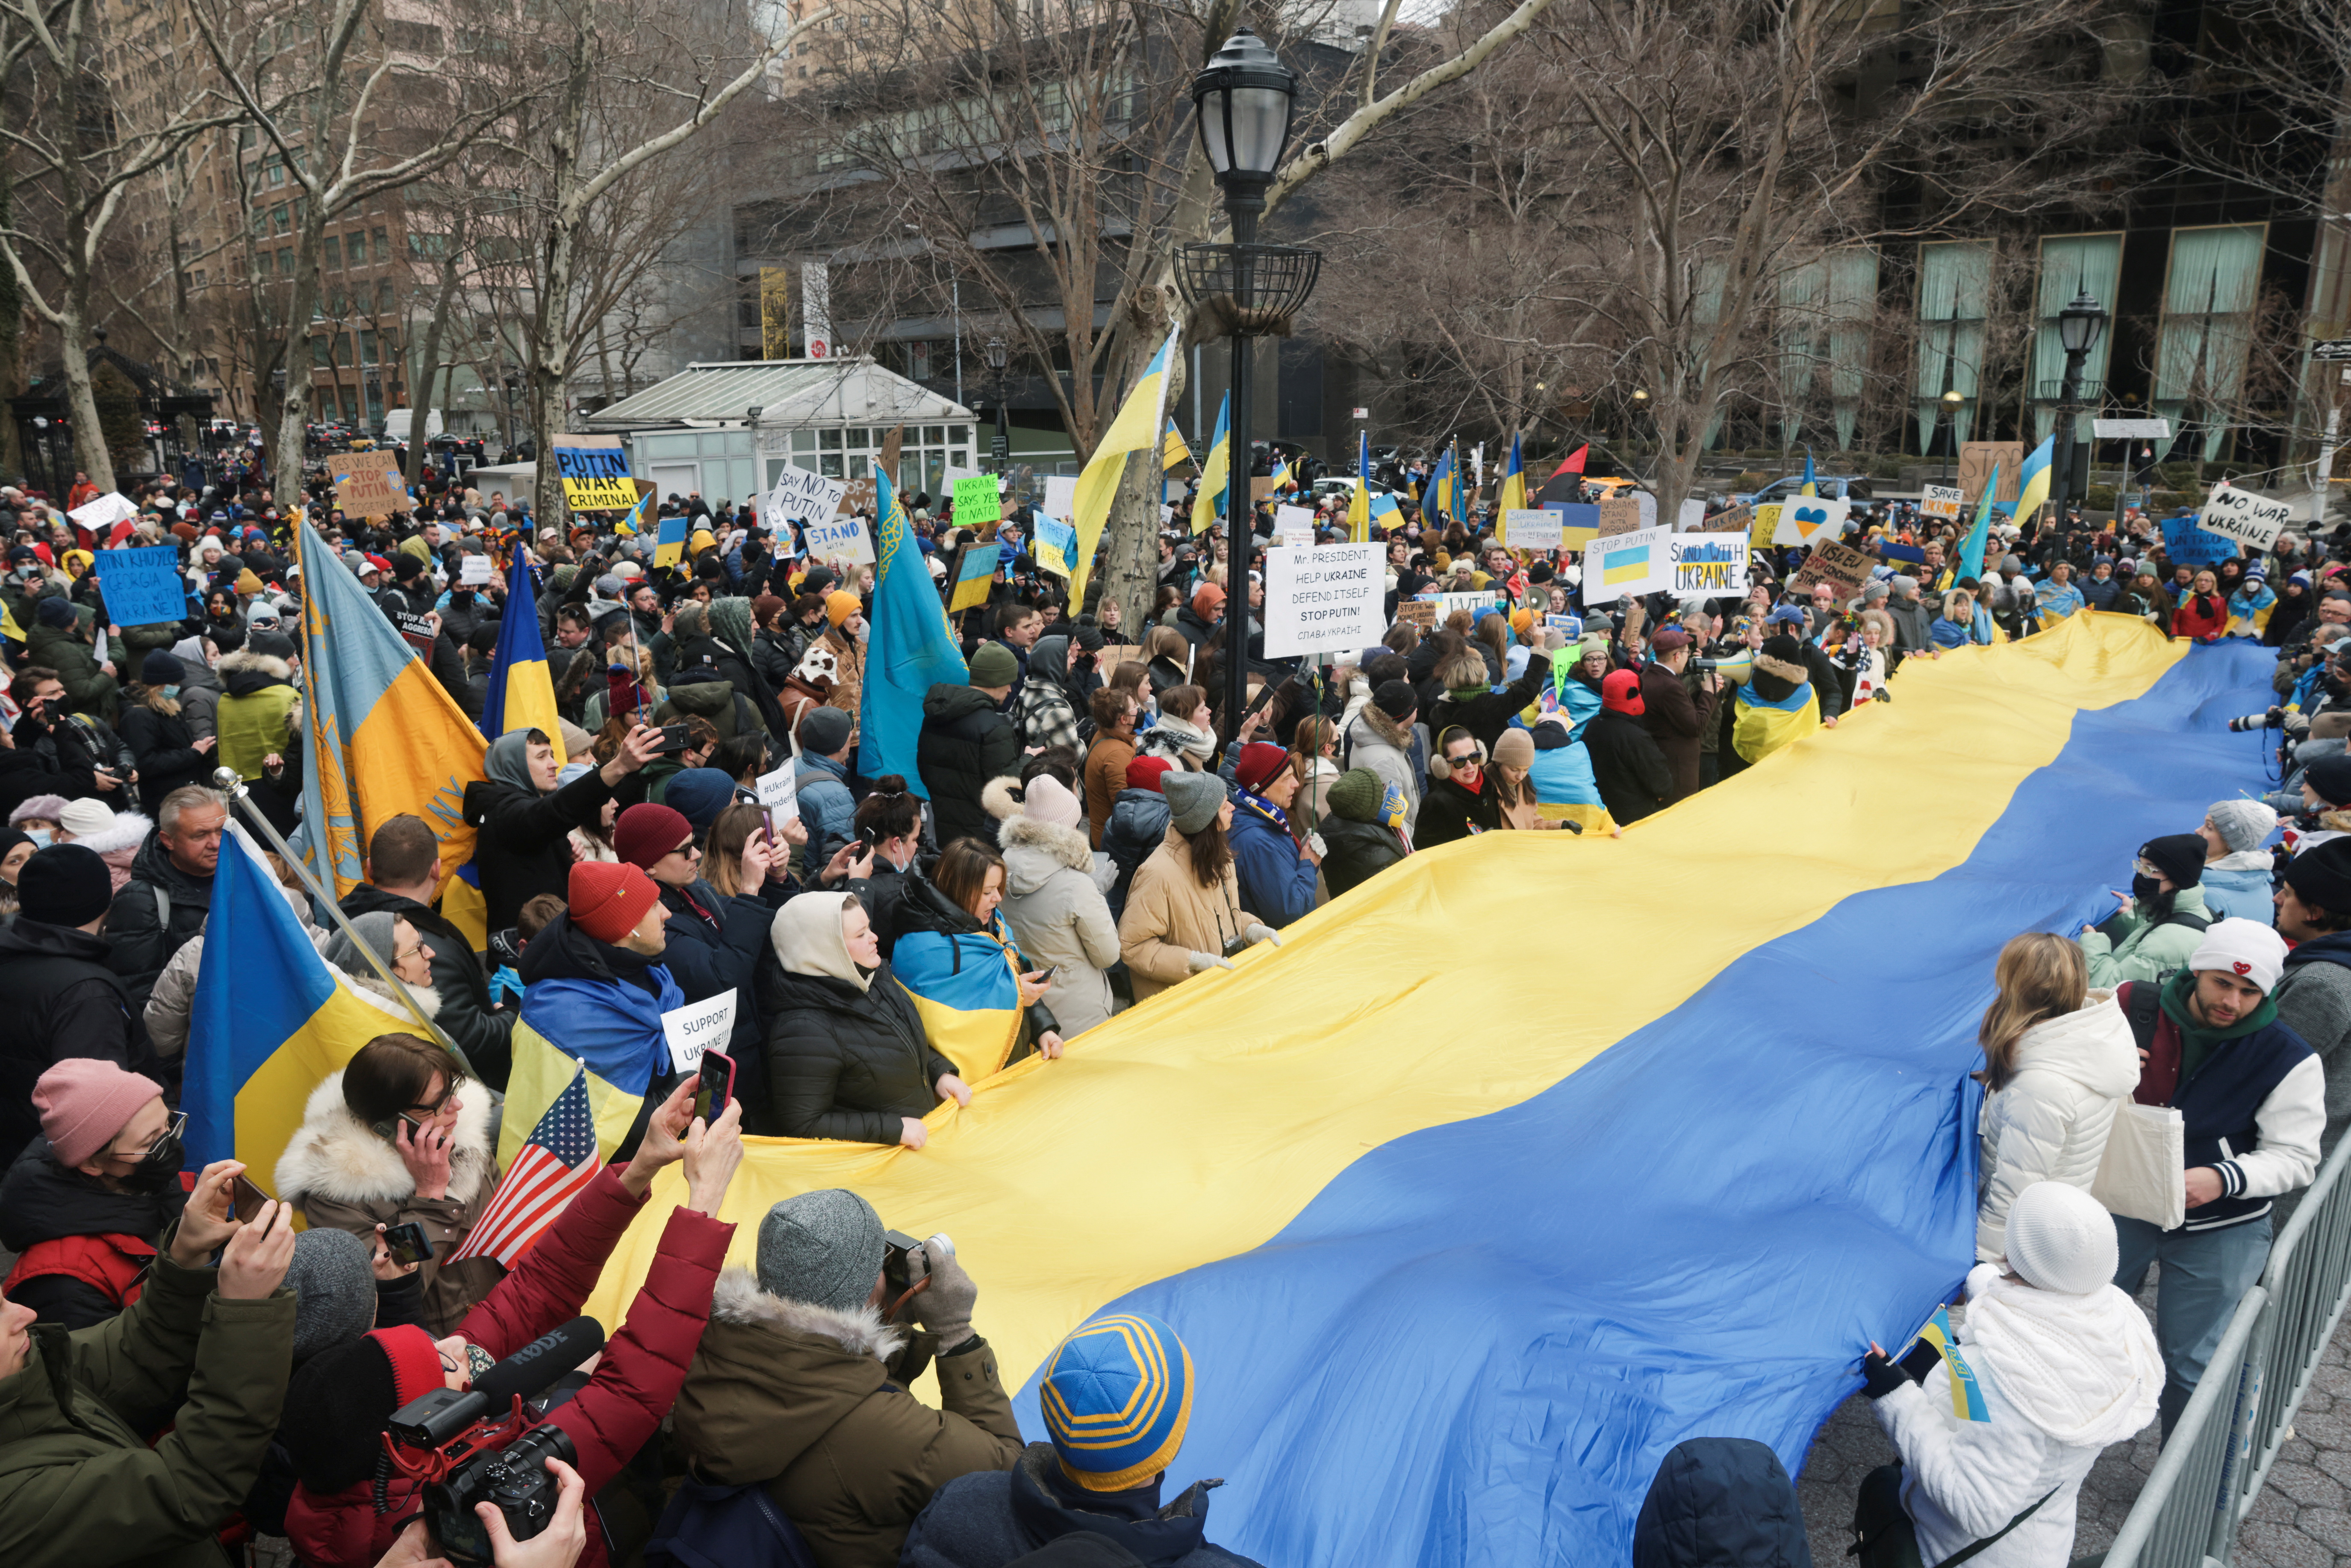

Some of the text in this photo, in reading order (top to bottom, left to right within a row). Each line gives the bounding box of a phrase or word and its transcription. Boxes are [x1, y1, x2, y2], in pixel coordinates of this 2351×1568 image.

[332, 454, 395, 471] YES WE CAN
[557, 453, 627, 473] PUTIN
[1962, 447, 2023, 478] STOP
[351, 469, 381, 483] STOP
[569, 472, 622, 490] WAR
[1252, 478, 1263, 486] OP
[350, 481, 389, 498] PUTIN
[781, 473, 841, 502] SAY NO TO
[958, 478, 996, 492] UKRAINE
[1930, 487, 1960, 500] SAVE
[349, 498, 399, 514] TOGETHER
[569, 494, 638, 507] CRIMINAL
[781, 492, 828, 520] PUTIN
[958, 492, 999, 507] SAYS YES
[2216, 492, 2289, 524] NO WAR
[96, 502, 130, 521] PUTN
[957, 506, 995, 520] TO NATO
[1602, 509, 1627, 518] STAND
[1708, 517, 1726, 530] FUCK
[1728, 506, 1751, 523] PUTIN
[810, 522, 859, 544] STAND
[1039, 520, 1044, 531] A
[1048, 523, 1064, 542] FREE
[2208, 513, 2274, 544] UKRAINE
[826, 541, 845, 550] WITH
[1593, 531, 1656, 554] STOP PUTIN
[1040, 550, 1046, 563] A
[1048, 552, 1064, 570] FREE
[1294, 550, 1371, 564] Mr. PRESIDENT,
[1670, 542, 1744, 562] STAND WITH
[1806, 555, 1827, 571] STOP
[1841, 554, 1864, 569] EU
[108, 572, 162, 592] GEORGIA
[1296, 569, 1367, 584] HELP UKRAINE
[1675, 564, 1740, 590] UKRAINE
[1292, 587, 1369, 604] DEFEND ITSELF
[396, 612, 418, 622] STOP
[1301, 607, 1360, 621] STOP PUTIN!
[1399, 604, 1416, 613] STOP
[1298, 630, 1326, 640] СЛАВА
[764, 775, 791, 794] #Ukraine
[683, 1008, 728, 1035] SUPPORT
[683, 1028, 729, 1061] UKRAINE!!!
[510, 1329, 569, 1365] RØDE
